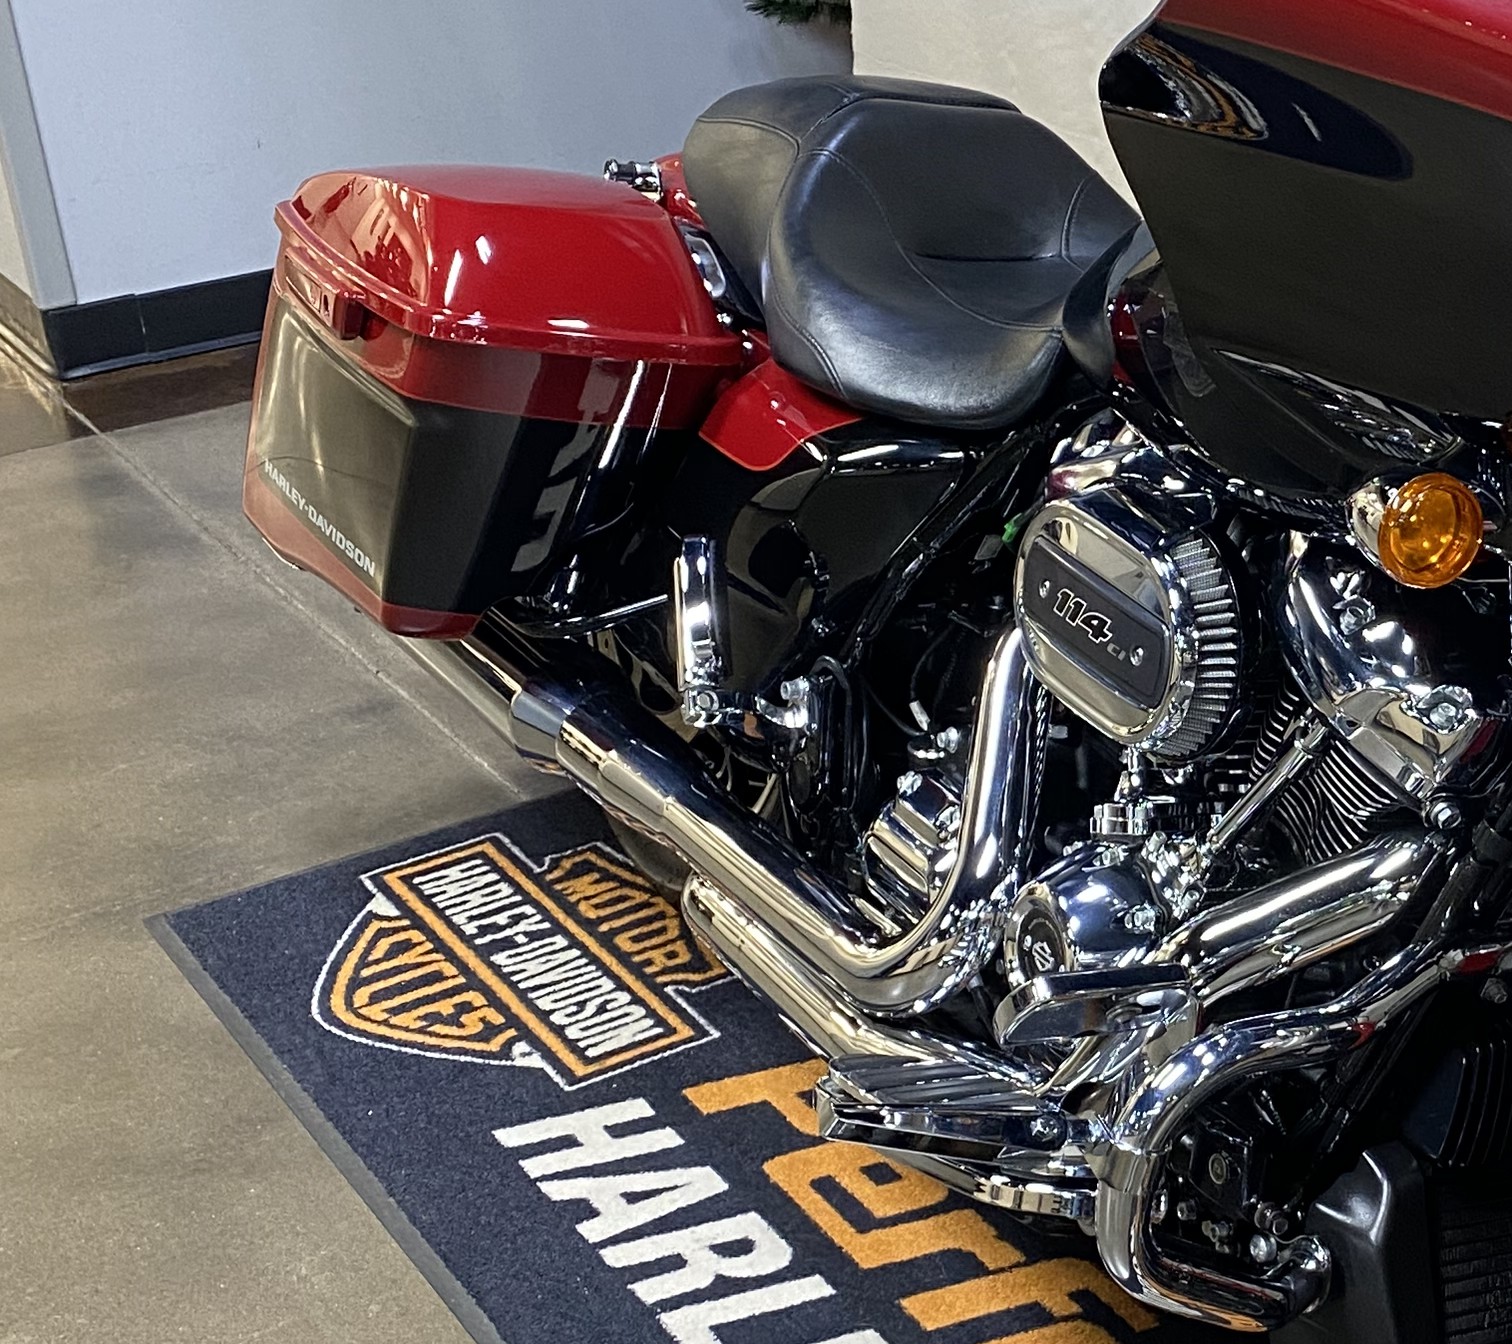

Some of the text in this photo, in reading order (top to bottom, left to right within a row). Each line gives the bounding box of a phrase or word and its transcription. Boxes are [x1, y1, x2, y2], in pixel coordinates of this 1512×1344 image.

[263, 458, 376, 577] HARLEY-DAVIDSON
[1053, 588, 1113, 644] 114
[353, 929, 507, 1037] CYCLES
[412, 858, 666, 1058] HARLEY-DAVIDSON
[551, 869, 694, 985] MOTOR
